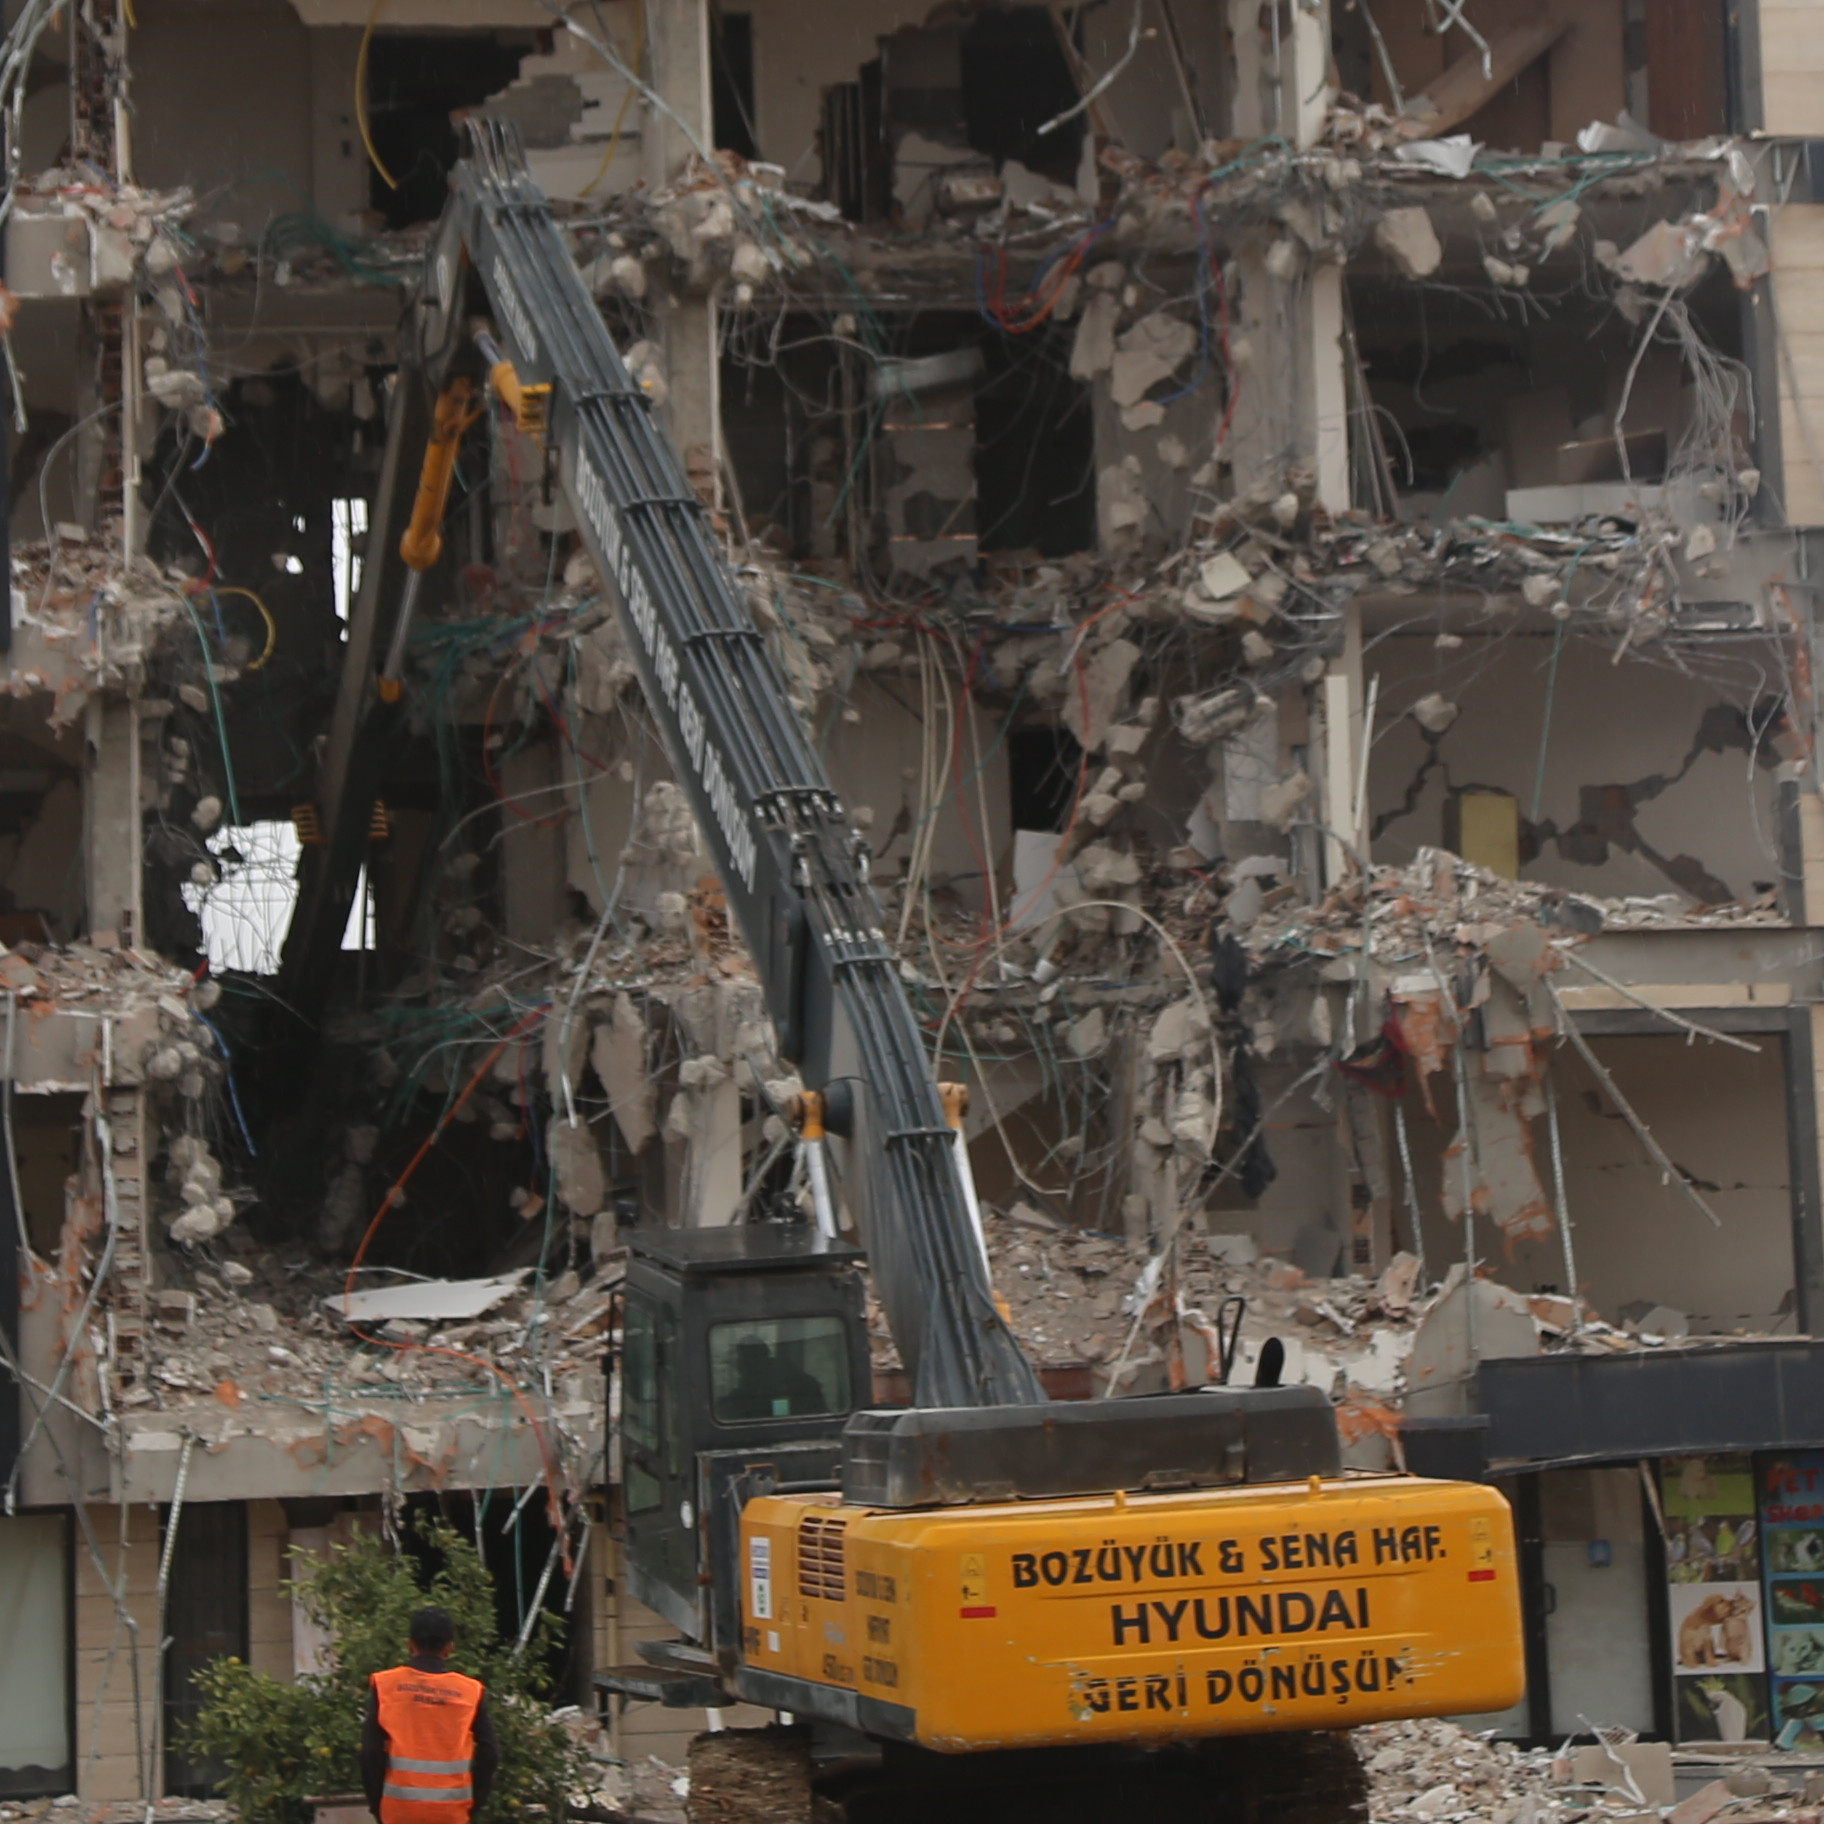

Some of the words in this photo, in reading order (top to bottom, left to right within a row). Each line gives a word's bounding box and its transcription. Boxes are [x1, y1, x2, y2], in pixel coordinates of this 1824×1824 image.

[1766, 1468, 1820, 1493] PET
[1011, 1535, 1205, 1588] BOZÜYÜK
[1218, 1539, 1244, 1574] &
[1259, 1530, 1358, 1571] SENA
[1372, 1526, 1447, 1566] HAF.
[1110, 1587, 1370, 1646] HYUNDAI
[1083, 1662, 1188, 1712] GERİ
